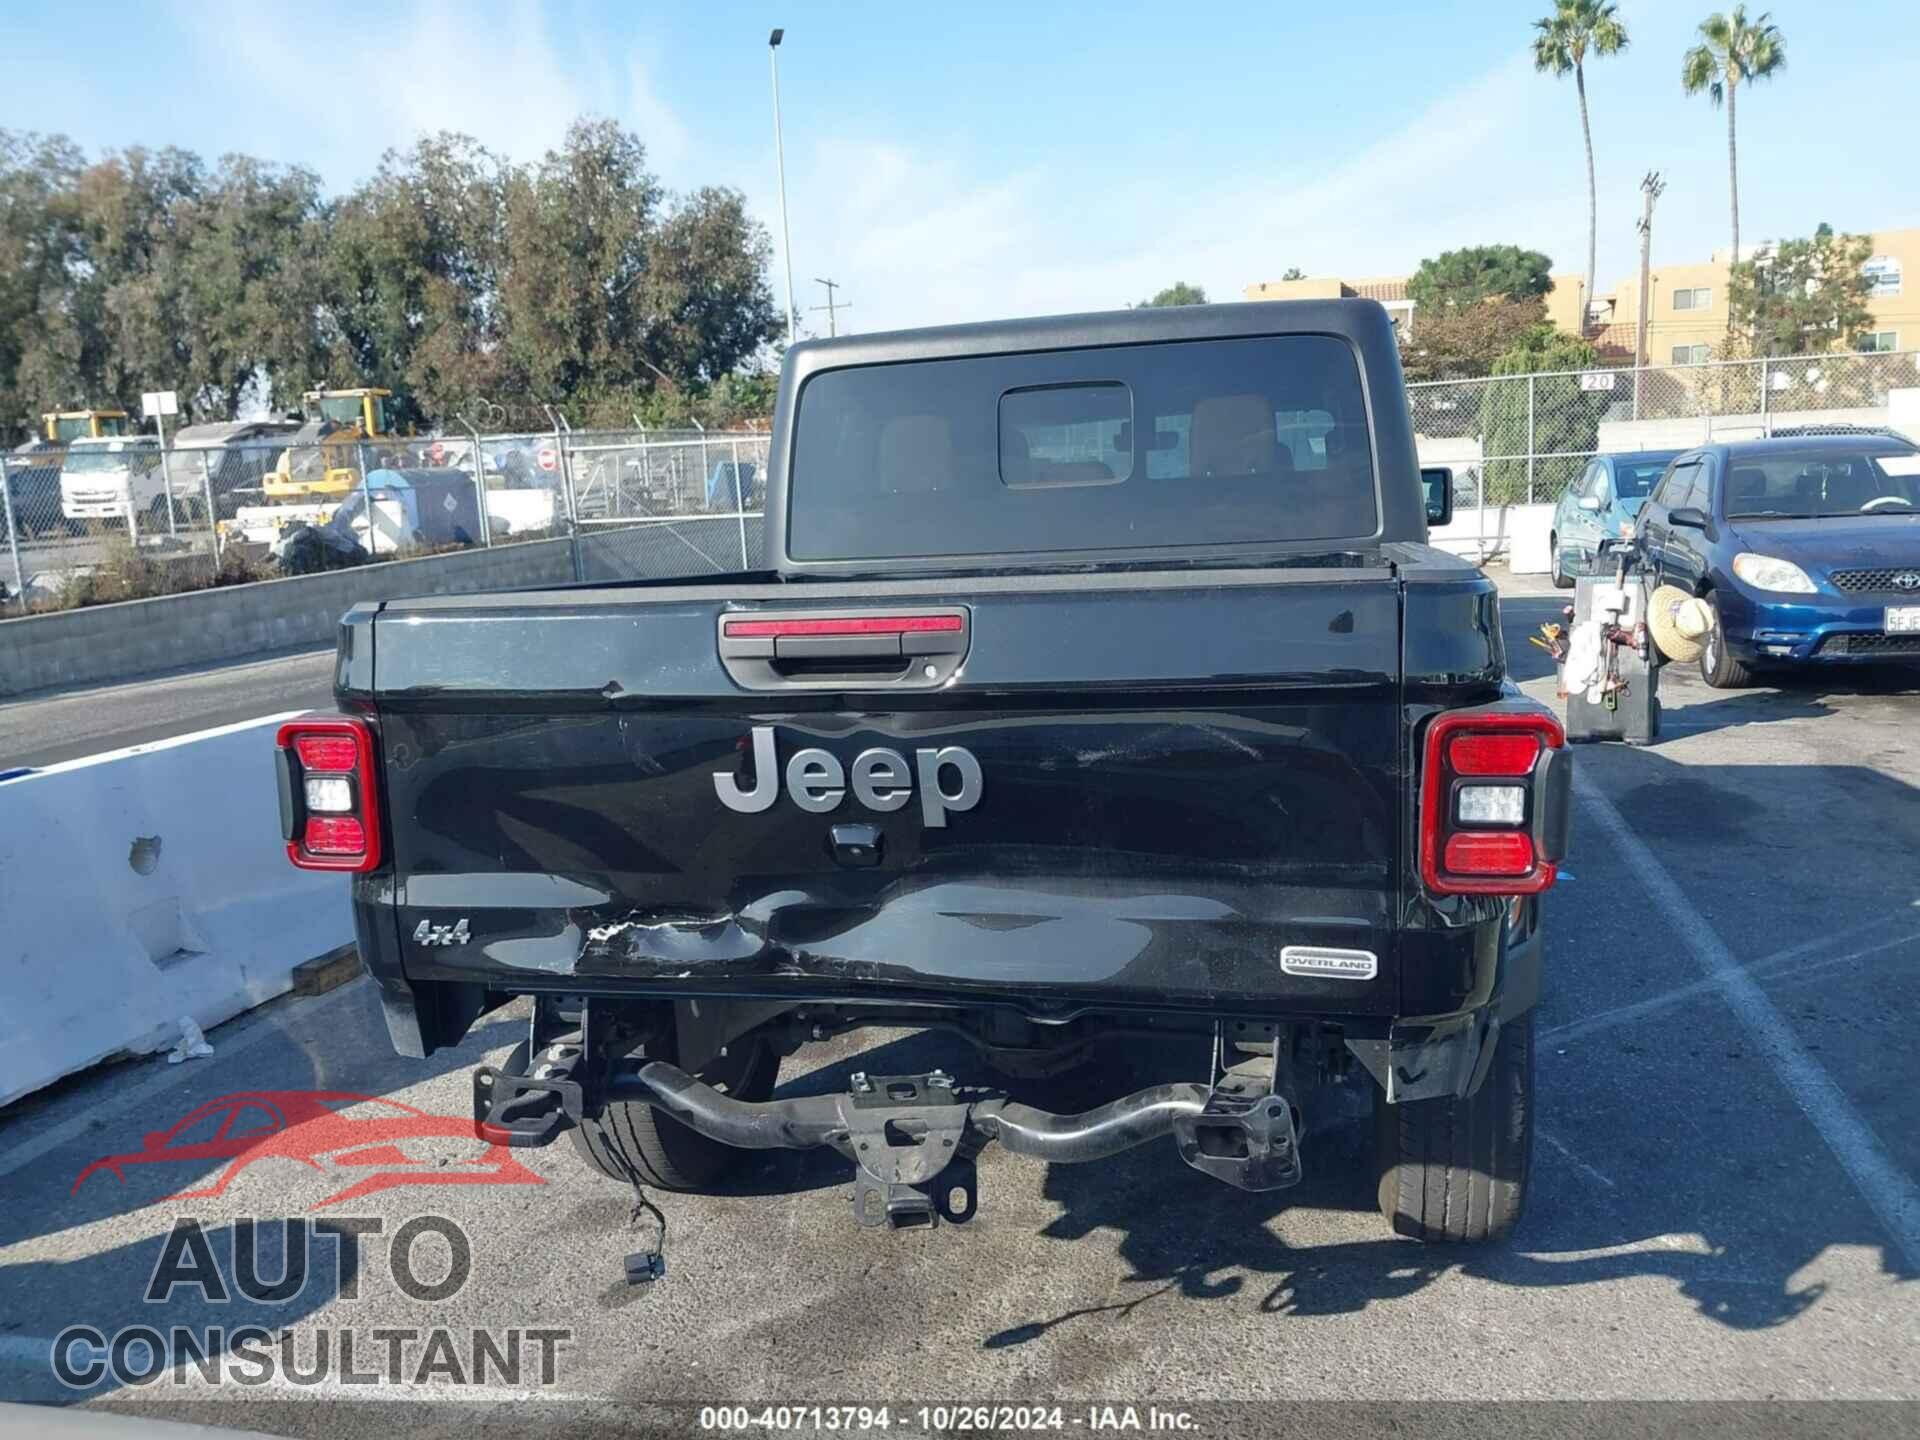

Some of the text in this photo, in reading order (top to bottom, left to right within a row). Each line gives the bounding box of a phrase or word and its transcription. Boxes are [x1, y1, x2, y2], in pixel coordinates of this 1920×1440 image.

[1588, 375, 1609, 389] 20
[712, 726, 983, 828] Jeep
[413, 918, 471, 946] 4x4
[1285, 957, 1372, 970] OVERLAND
